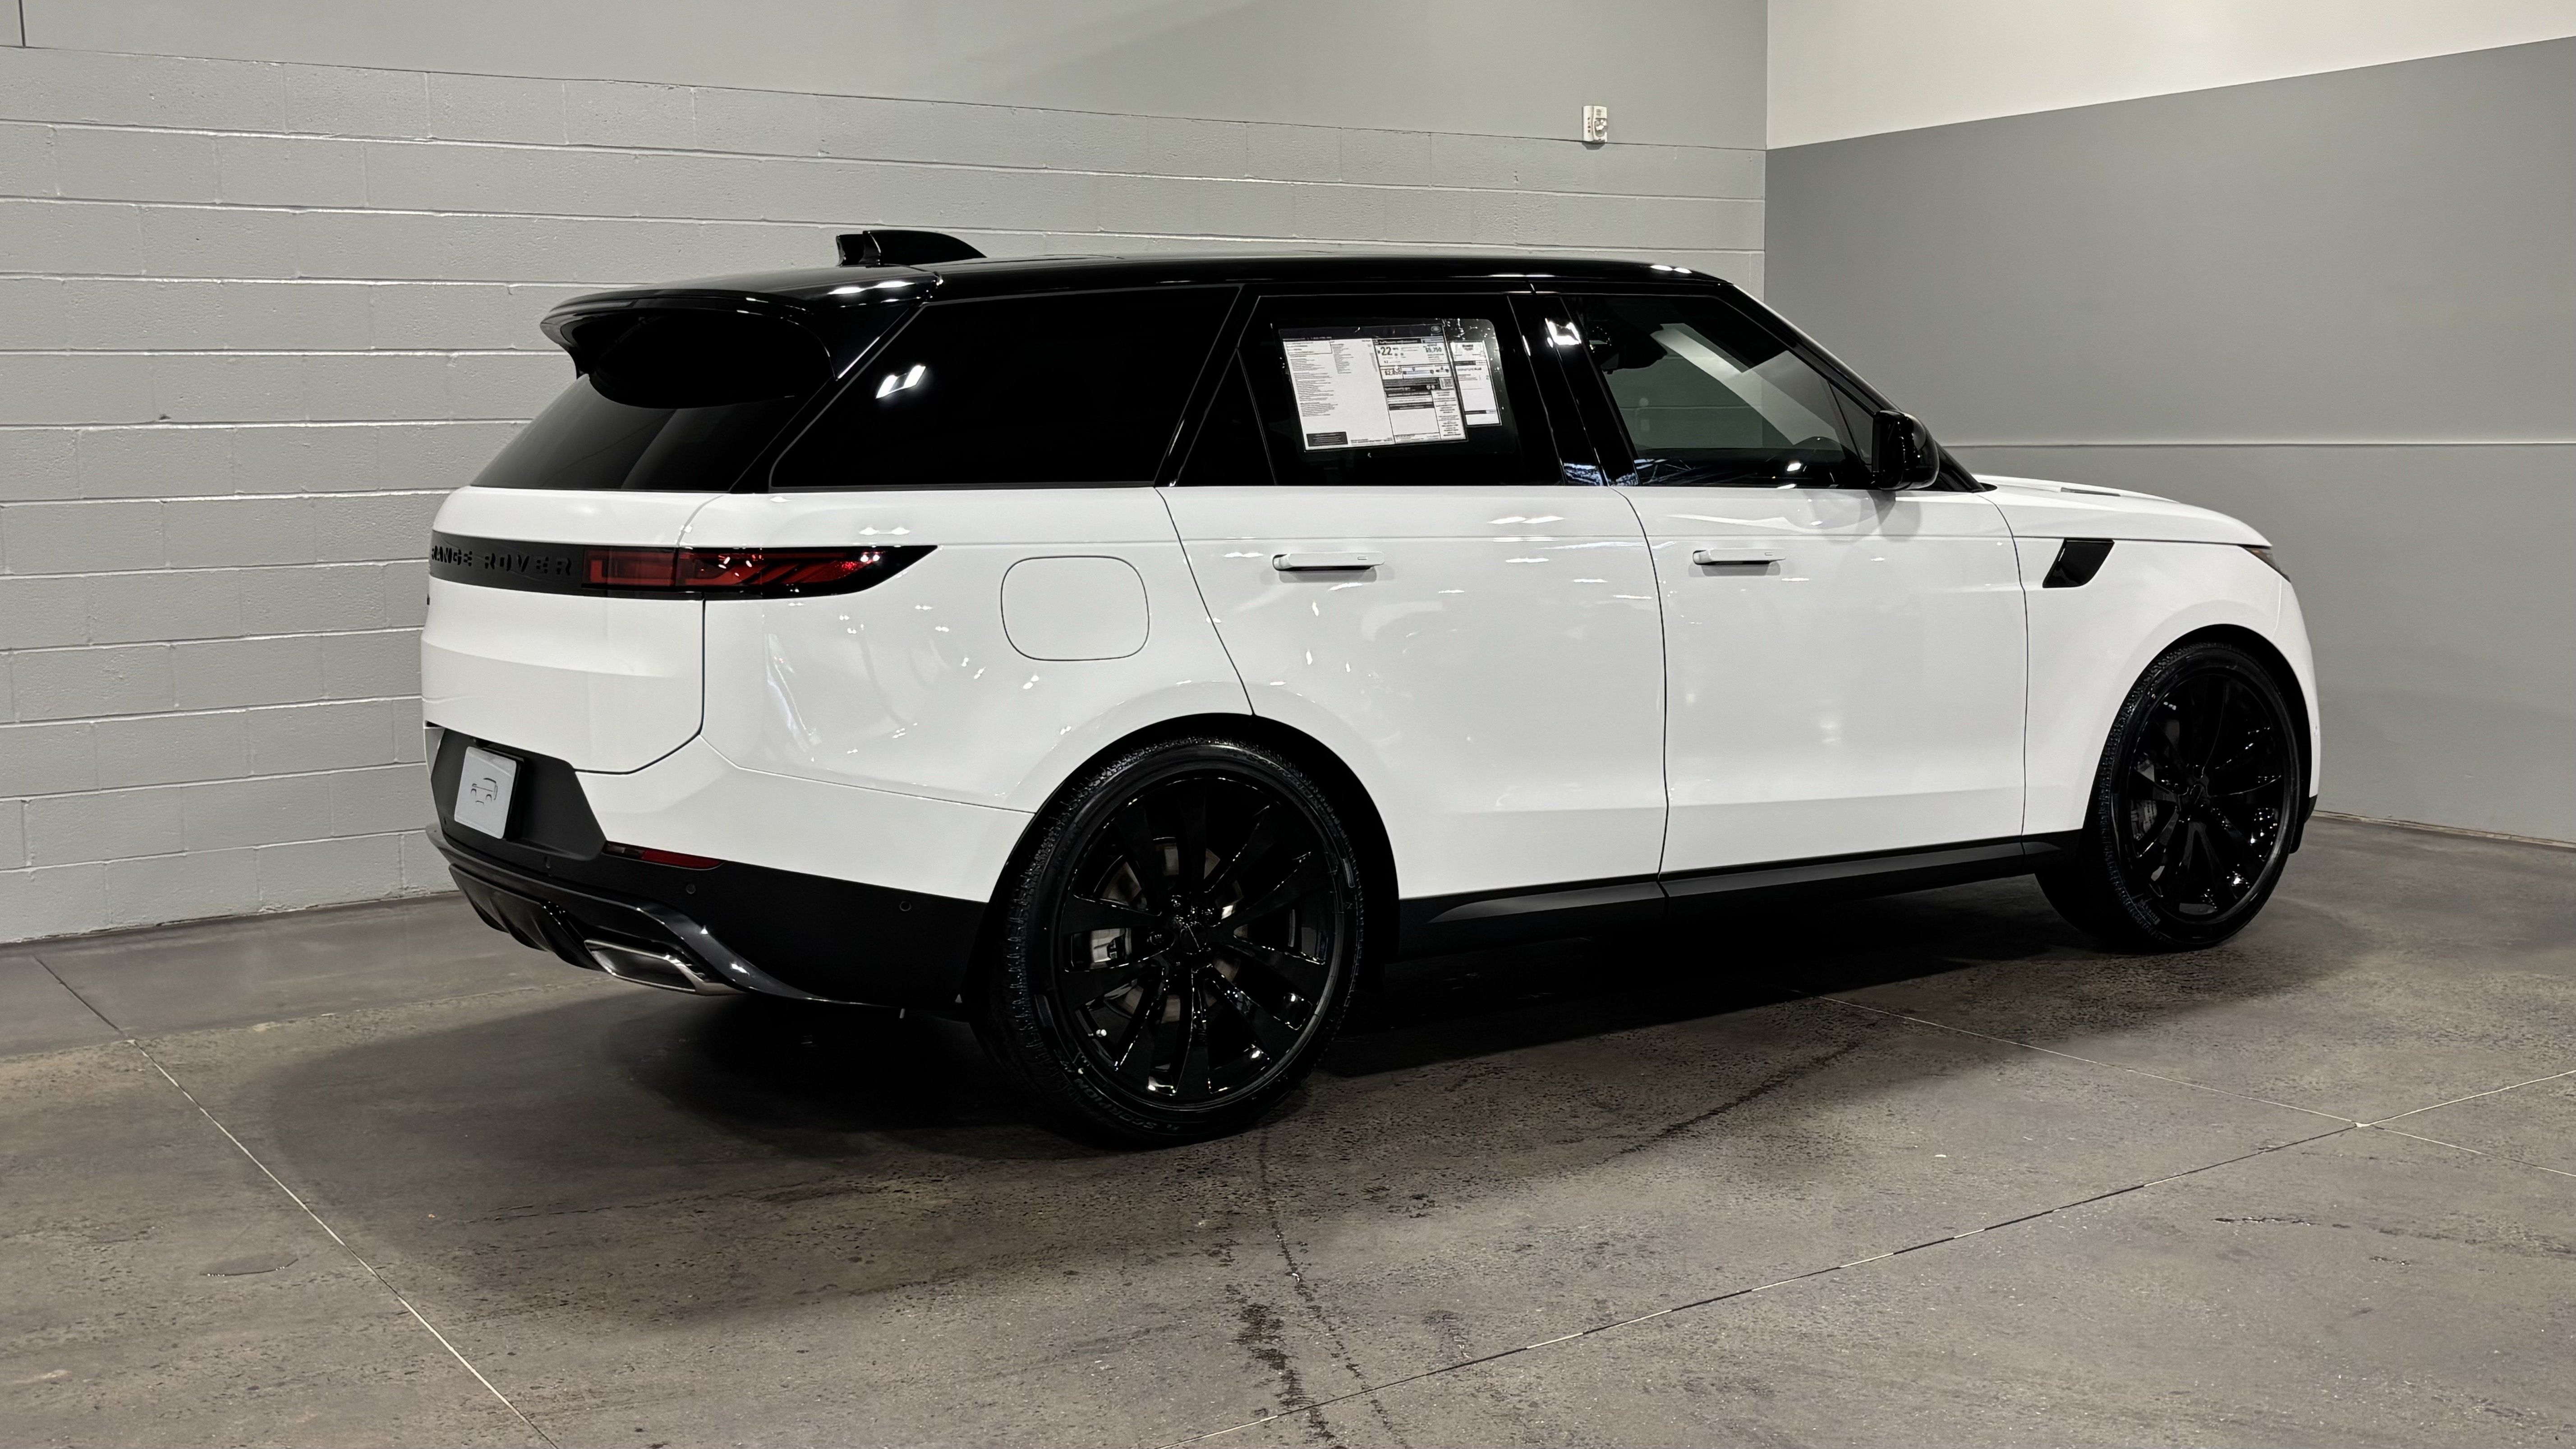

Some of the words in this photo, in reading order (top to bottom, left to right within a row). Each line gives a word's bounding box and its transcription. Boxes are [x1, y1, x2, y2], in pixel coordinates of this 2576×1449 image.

[1380, 347, 1392, 355] 22
[432, 545, 472, 566] RANGE
[484, 553, 571, 576] ROVER
